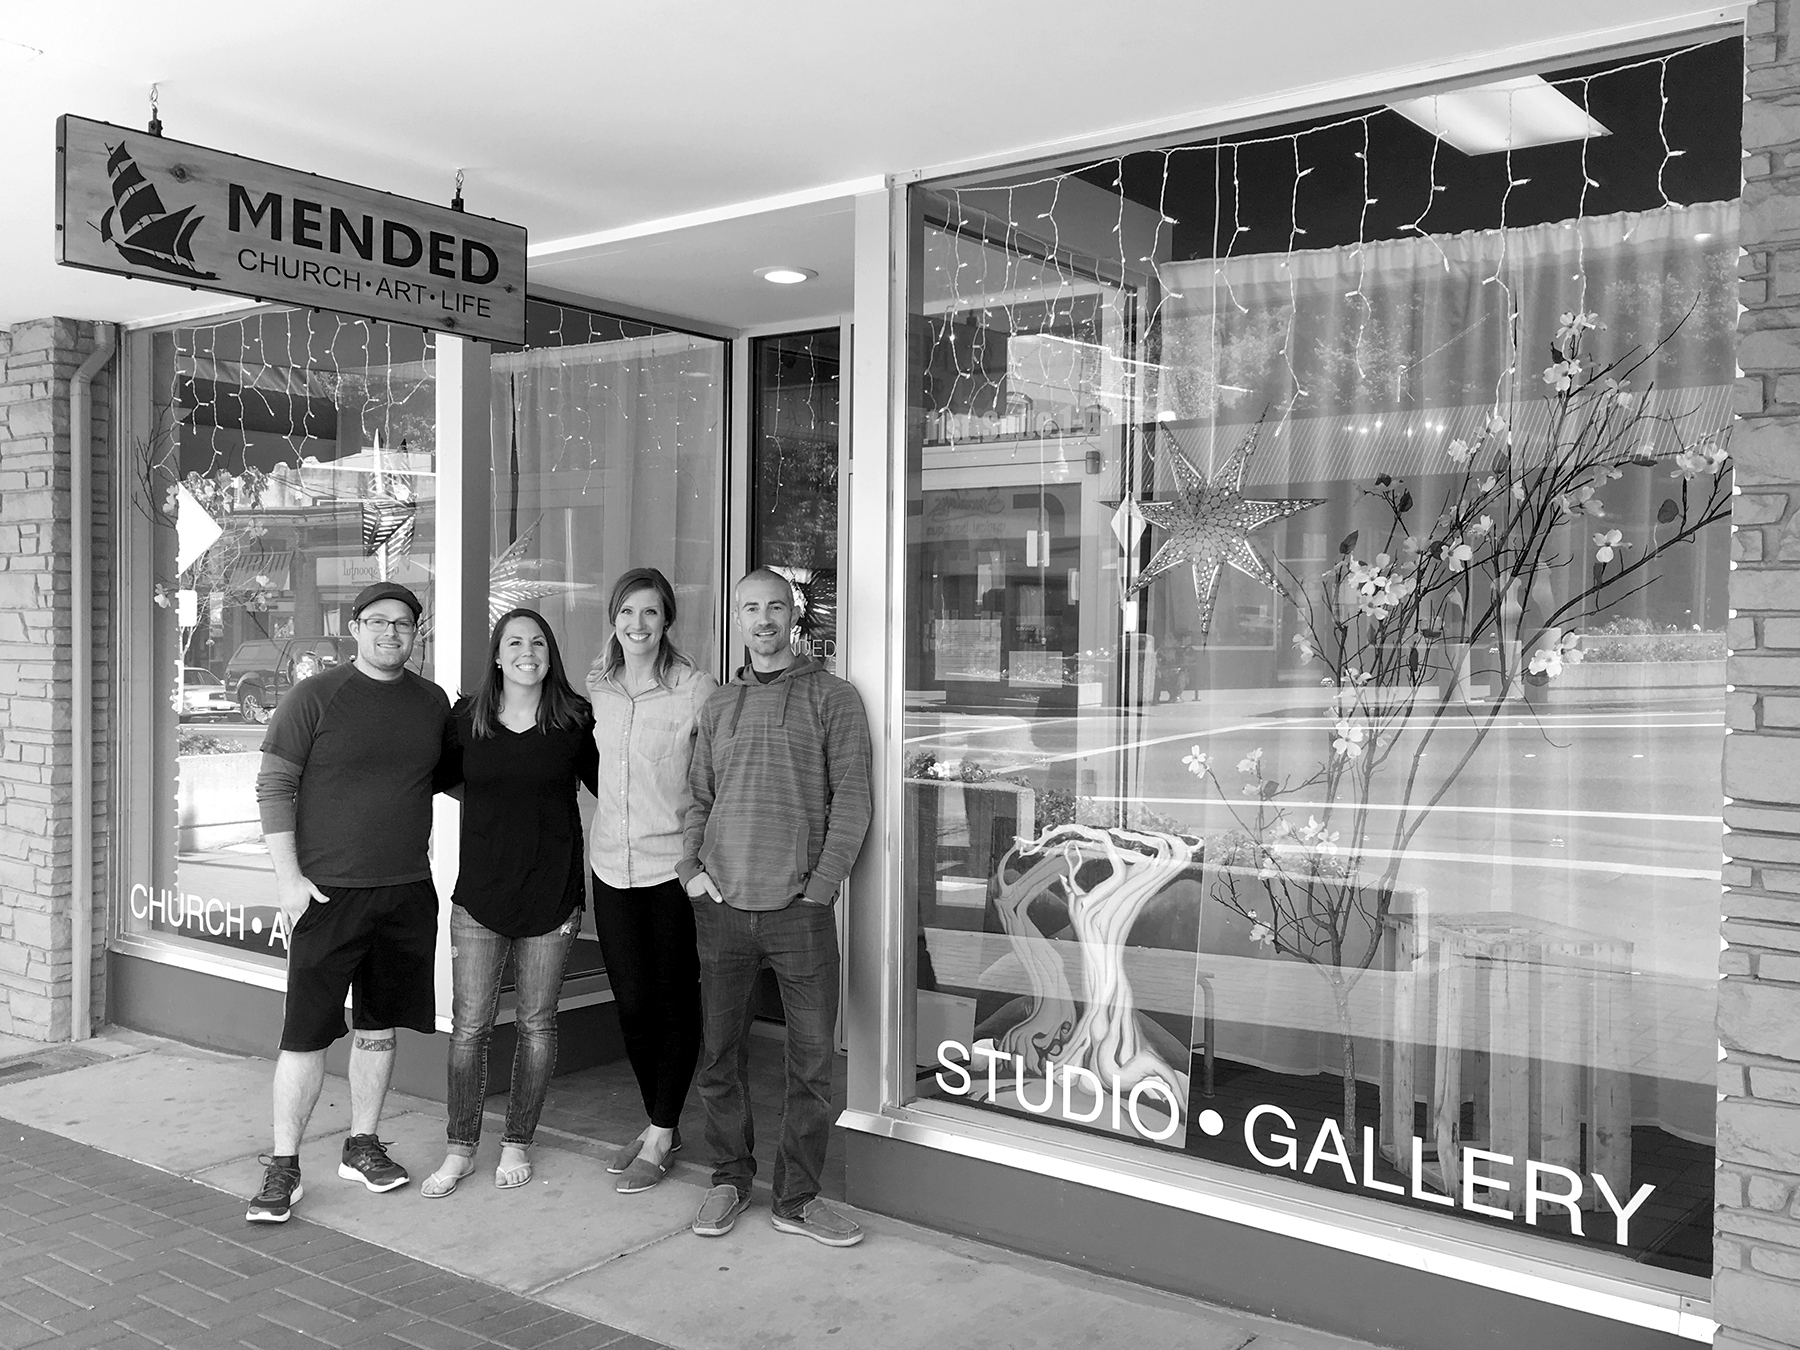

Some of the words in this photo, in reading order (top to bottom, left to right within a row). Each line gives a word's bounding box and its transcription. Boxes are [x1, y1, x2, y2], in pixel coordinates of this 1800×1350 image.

[229, 183, 499, 284] MENDED
[237, 249, 360, 291] CHURCH
[376, 278, 427, 304] ART
[441, 290, 491, 318] LIFE
[130, 883, 244, 941] CHURCH
[935, 1040, 1179, 1141] STUDIO
[1244, 1104, 1656, 1246] GALLERY
